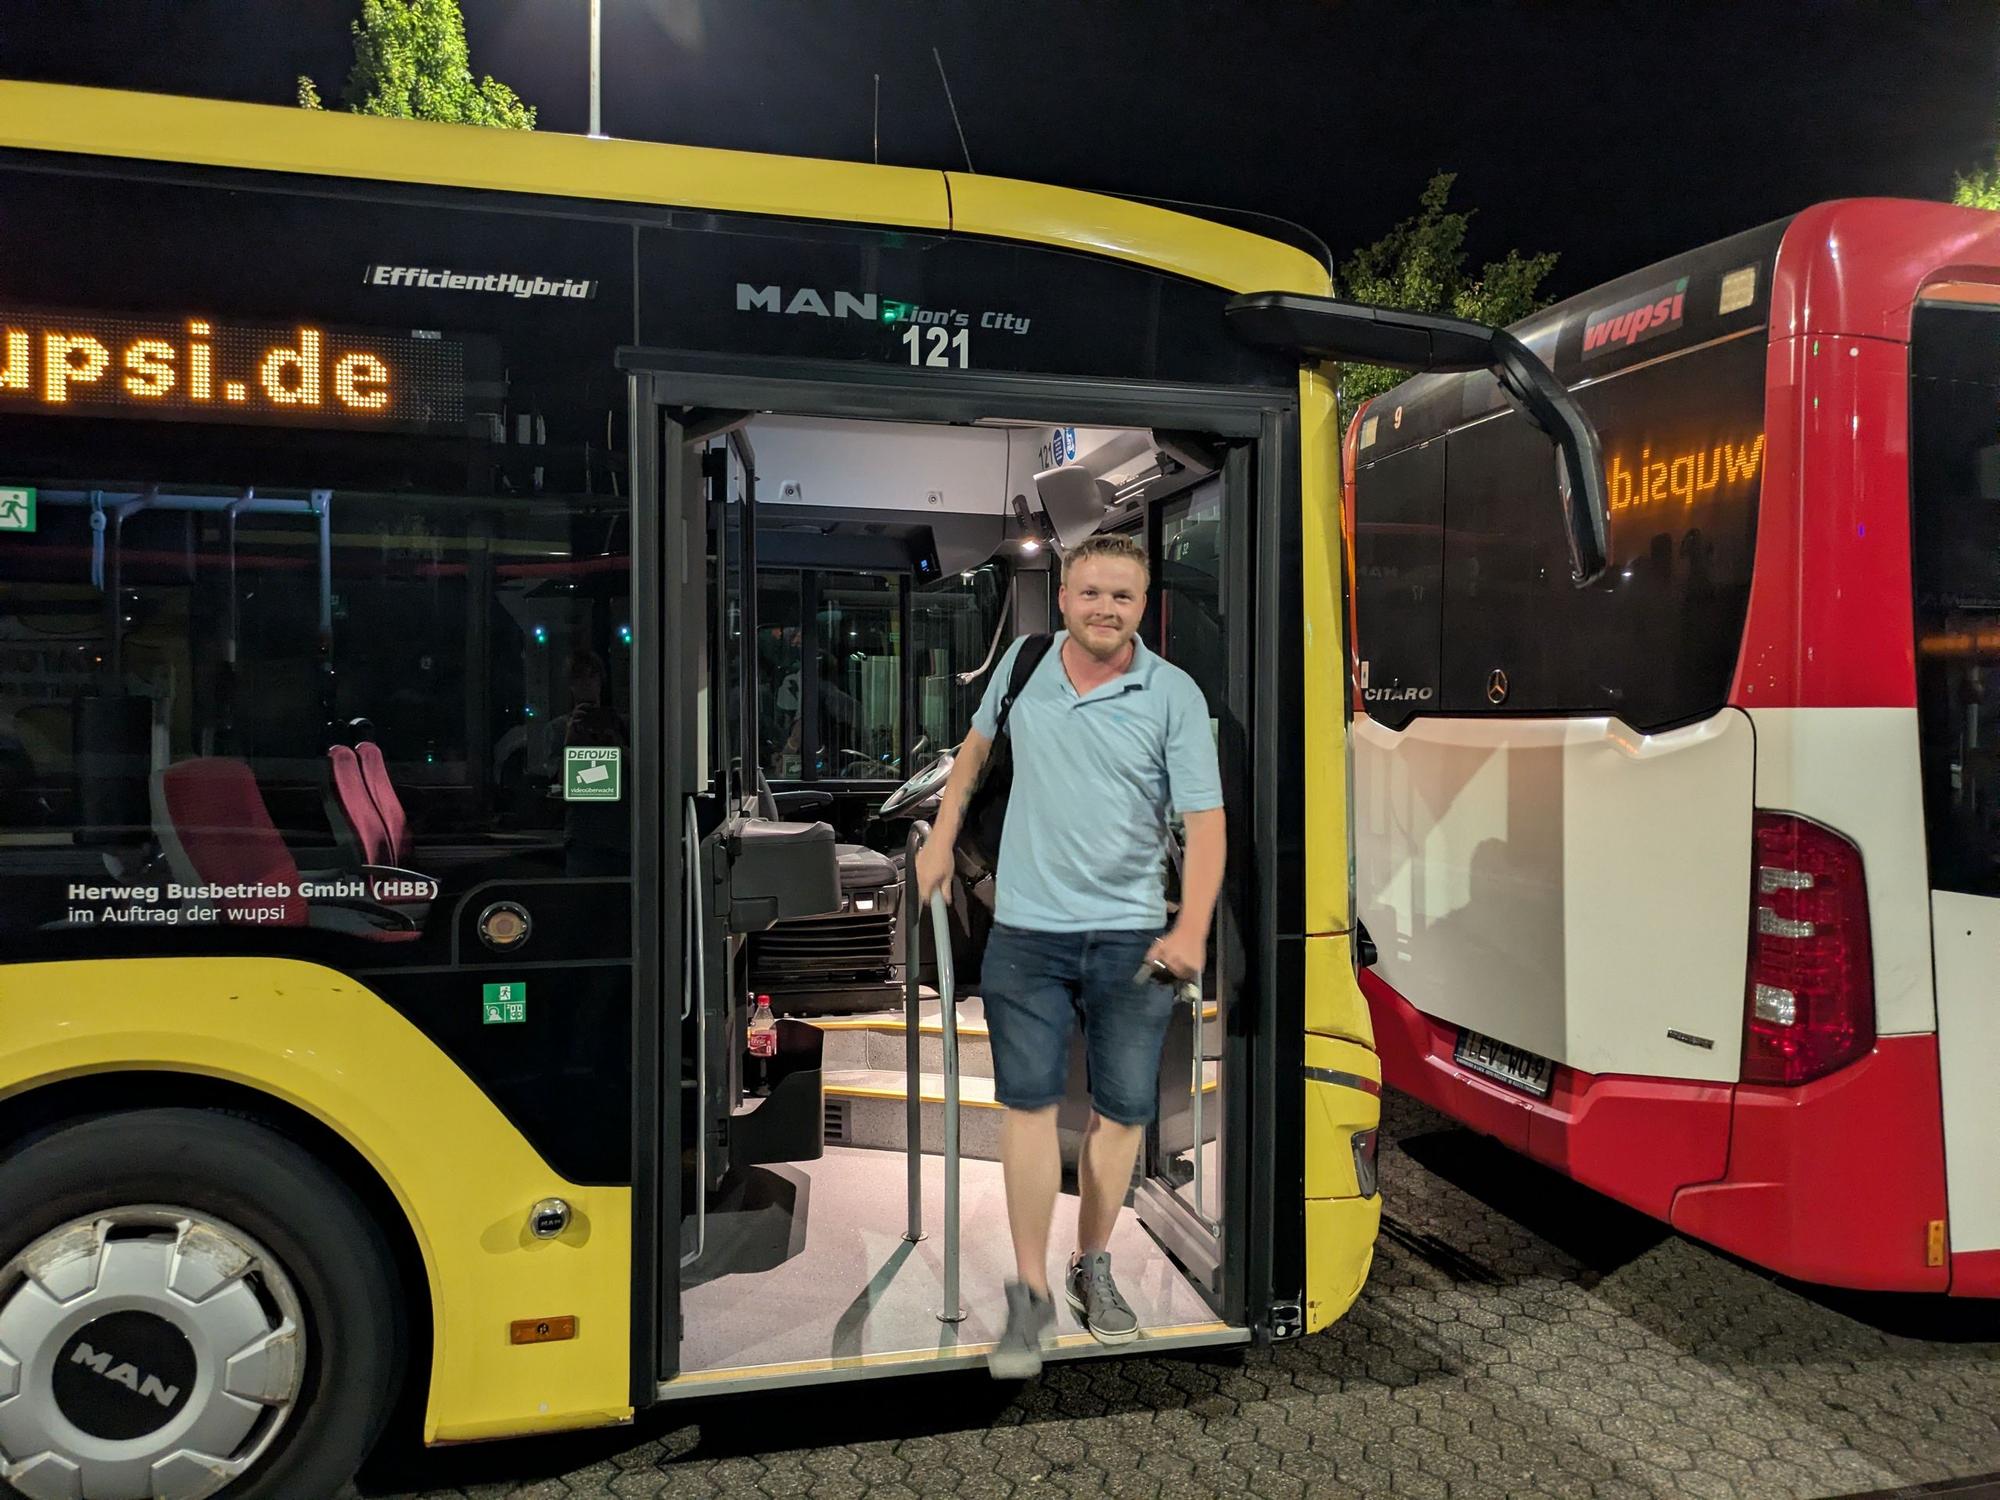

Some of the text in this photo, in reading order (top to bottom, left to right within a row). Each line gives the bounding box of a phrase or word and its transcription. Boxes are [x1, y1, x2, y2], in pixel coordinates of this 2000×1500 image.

[373, 266, 590, 299] EfficientHybrid
[736, 283, 877, 320] MAN
[1583, 276, 1690, 352] wupsi
[980, 311, 1031, 335] City
[902, 325, 969, 369] 121
[1394, 406, 1402, 429] 9
[1365, 687, 1433, 701] CITARO
[68, 881, 439, 902] Herweg Busbetrieb GmbH (HBB)
[68, 905, 285, 925] im Auftrag der wupsi
[70, 1342, 180, 1407] MAN
